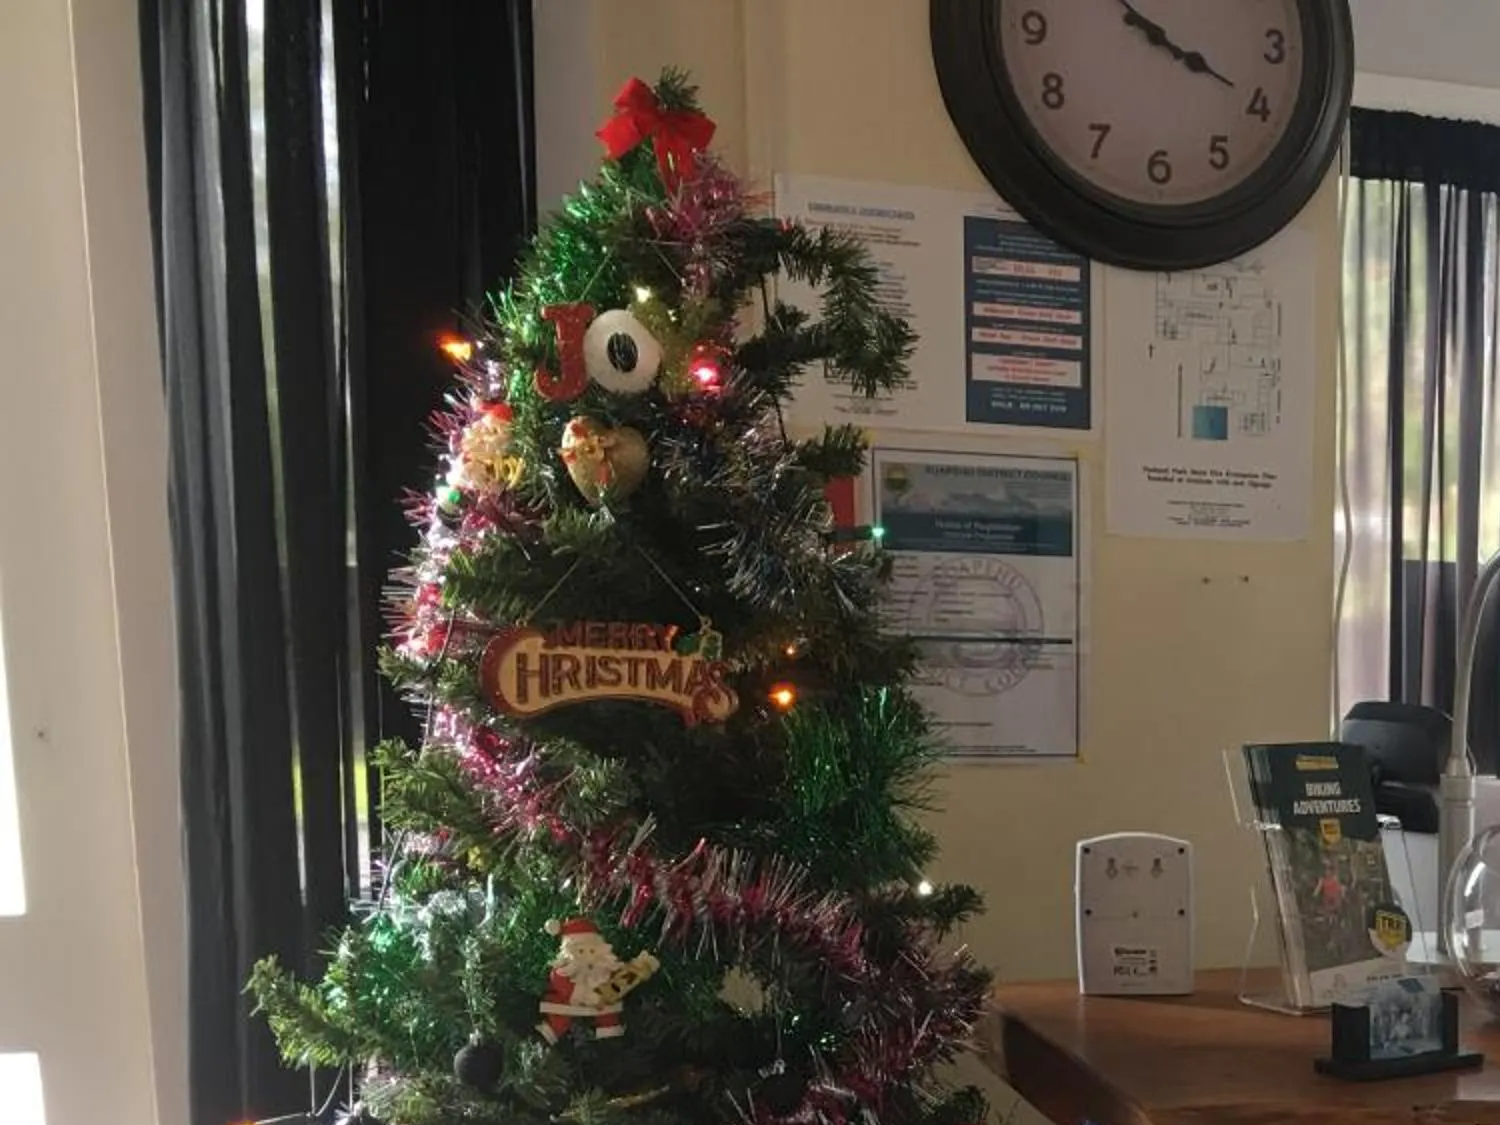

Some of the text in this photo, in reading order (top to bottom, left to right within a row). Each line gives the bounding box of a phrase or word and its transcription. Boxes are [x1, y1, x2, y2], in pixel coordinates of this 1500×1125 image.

[1021, 10, 1048, 45] 9
[1263, 29, 1286, 65] 3
[1041, 73, 1065, 110] 8
[1245, 87, 1271, 122] 4
[1088, 123, 1112, 160] 7
[1208, 135, 1230, 170] 5
[1147, 150, 1172, 184] 6
[552, 620, 682, 651] MERRY
[1293, 799, 1361, 816] ADVENTURES
